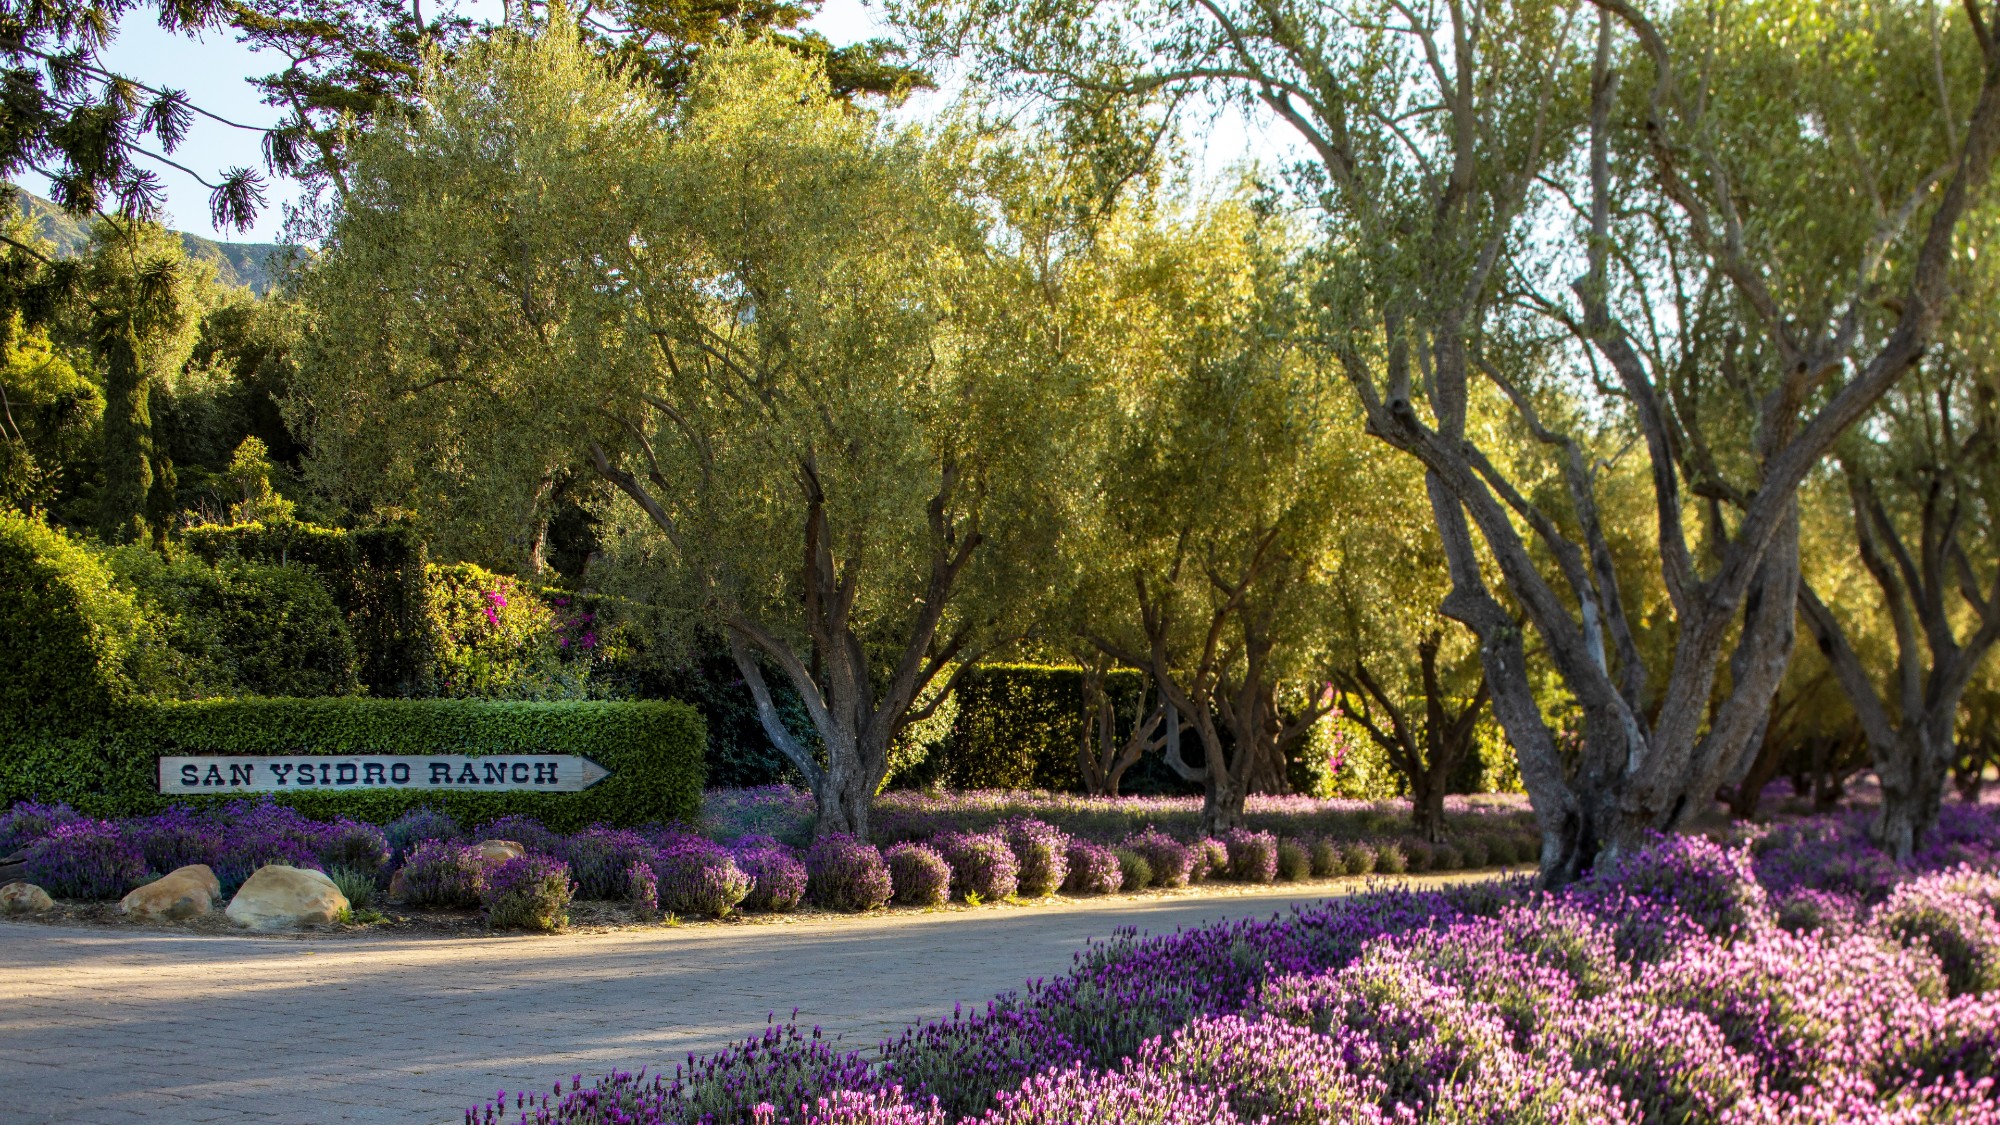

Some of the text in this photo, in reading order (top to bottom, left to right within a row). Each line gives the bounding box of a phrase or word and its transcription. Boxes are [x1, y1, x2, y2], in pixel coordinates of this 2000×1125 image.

[180, 762, 559, 786] SAN YSIDRO RANCH
